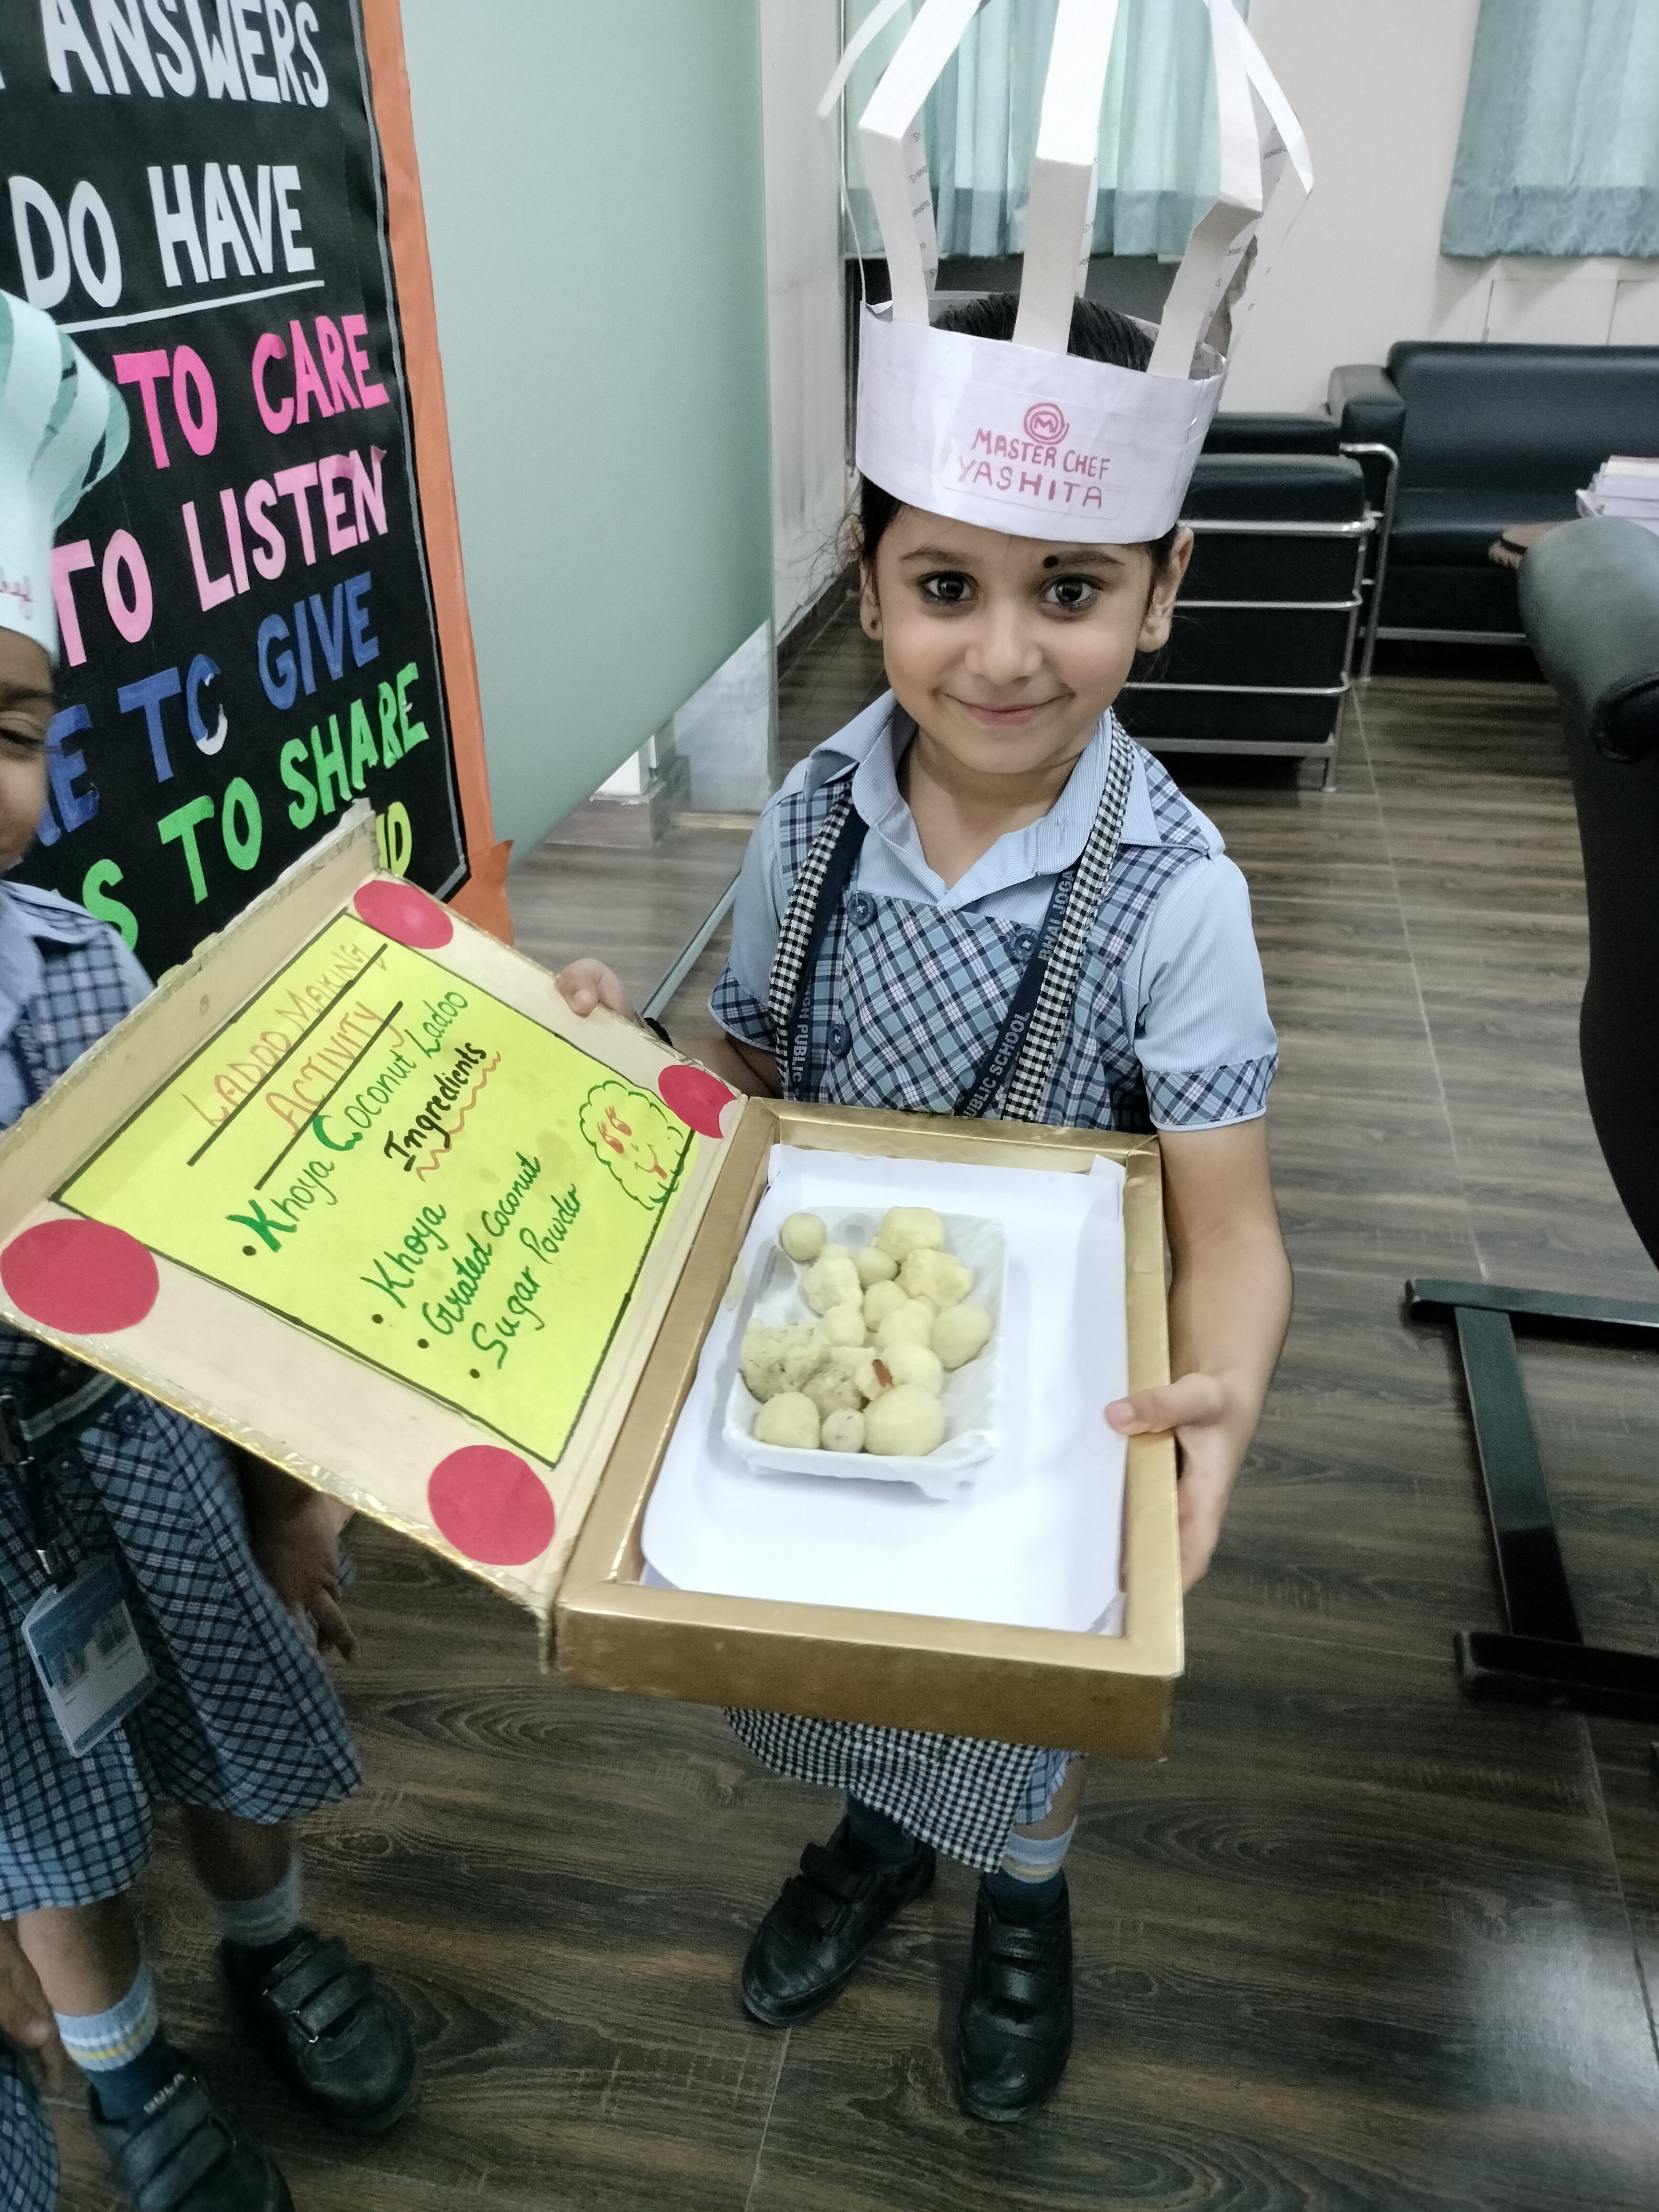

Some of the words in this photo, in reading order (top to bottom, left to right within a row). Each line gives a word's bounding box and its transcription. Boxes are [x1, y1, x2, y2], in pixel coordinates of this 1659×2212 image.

[40, 0, 329, 108] ANSWERS
[8, 175, 122, 310] DO
[148, 163, 315, 288] HAVE
[113, 345, 218, 469] TO
[252, 314, 389, 434] CARE
[957, 454, 1102, 509] YASHITA
[971, 427, 1057, 467] MASTER
[1063, 449, 1111, 480] CHEF
[51, 529, 153, 667] TO
[182, 446, 388, 611] LISTEN
[257, 572, 379, 710] GIVE
[157, 776, 262, 904] TO
[280, 662, 429, 830] SHARE
[1052, 869, 1076, 915] JOGA
[274, 943, 387, 1033] MAKING
[265, 1001, 405, 1136] ACTIVITY
[384, 1042, 487, 1172] Ingredients
[792, 1024, 808, 1083] PUBLIC
[962, 1077, 996, 1117] UBLIC
[989, 1012, 1030, 1076] SCHOOL
[225, 1161, 338, 1253] Khoya
[312, 1049, 417, 1152] Coconut
[404, 991, 468, 1059] Ladoo
[360, 1204, 449, 1309] Khoya
[422, 1232, 492, 1335] Grated
[471, 1265, 545, 1370] Sugar
[519, 1183, 582, 1265] Powder
